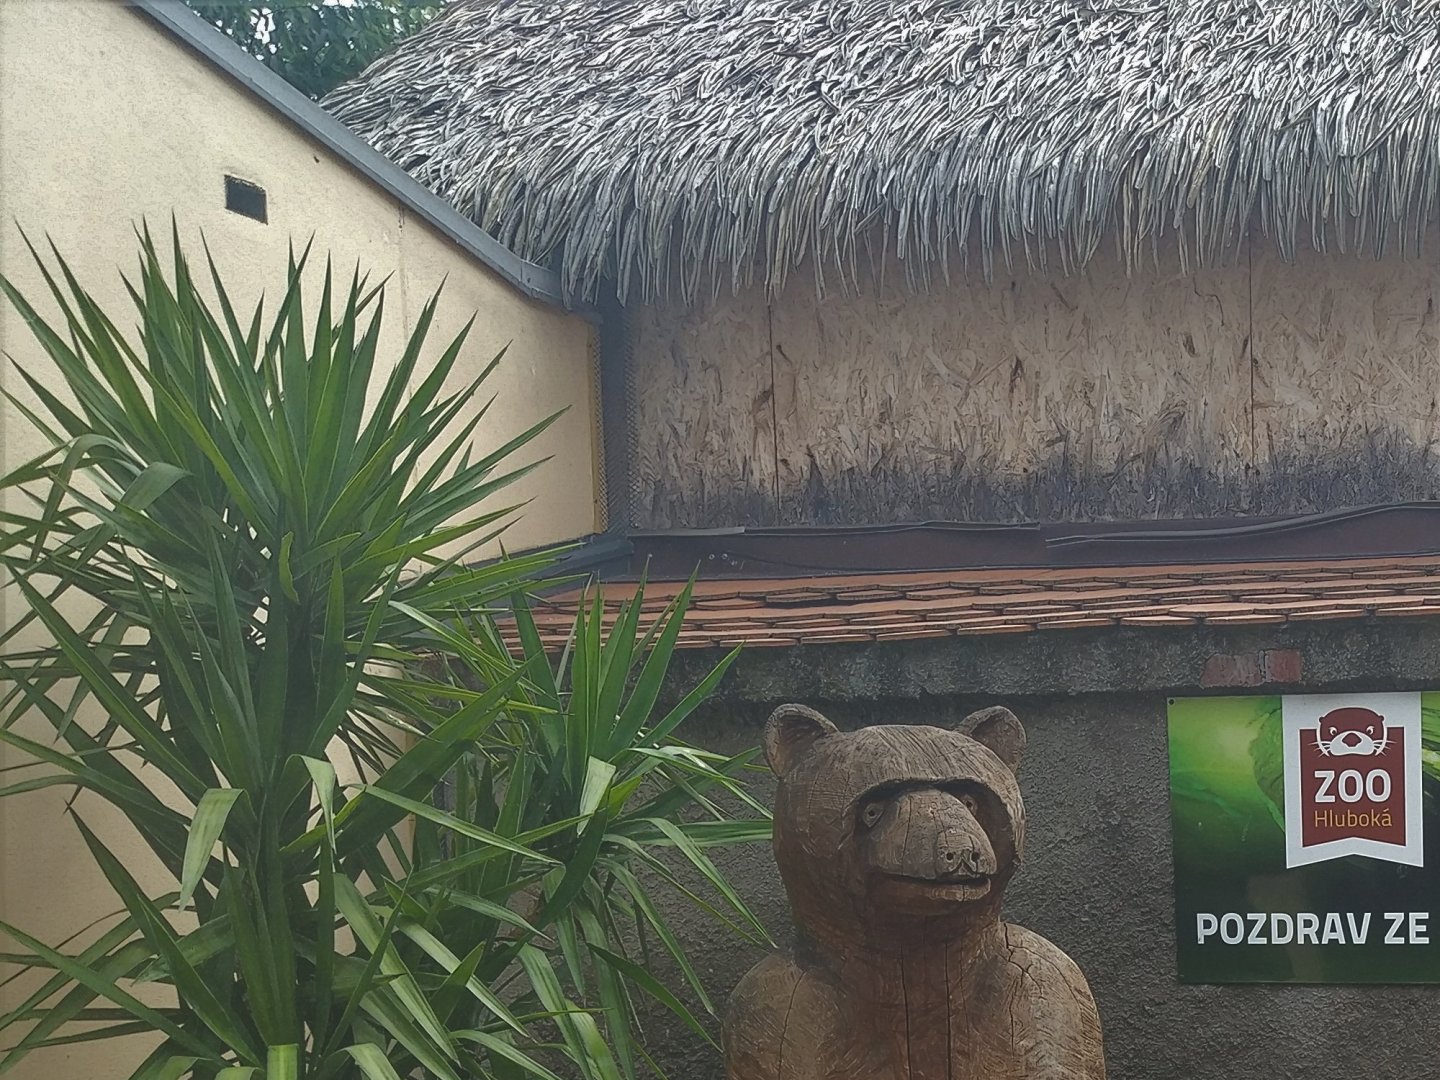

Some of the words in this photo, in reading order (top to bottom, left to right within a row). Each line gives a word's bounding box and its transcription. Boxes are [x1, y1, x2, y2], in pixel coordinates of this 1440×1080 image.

[1313, 769, 1392, 803] ZOO
[1314, 808, 1393, 828] Hluboká
[1196, 912, 1372, 945] POZDRAV
[1383, 912, 1430, 944] ZE
